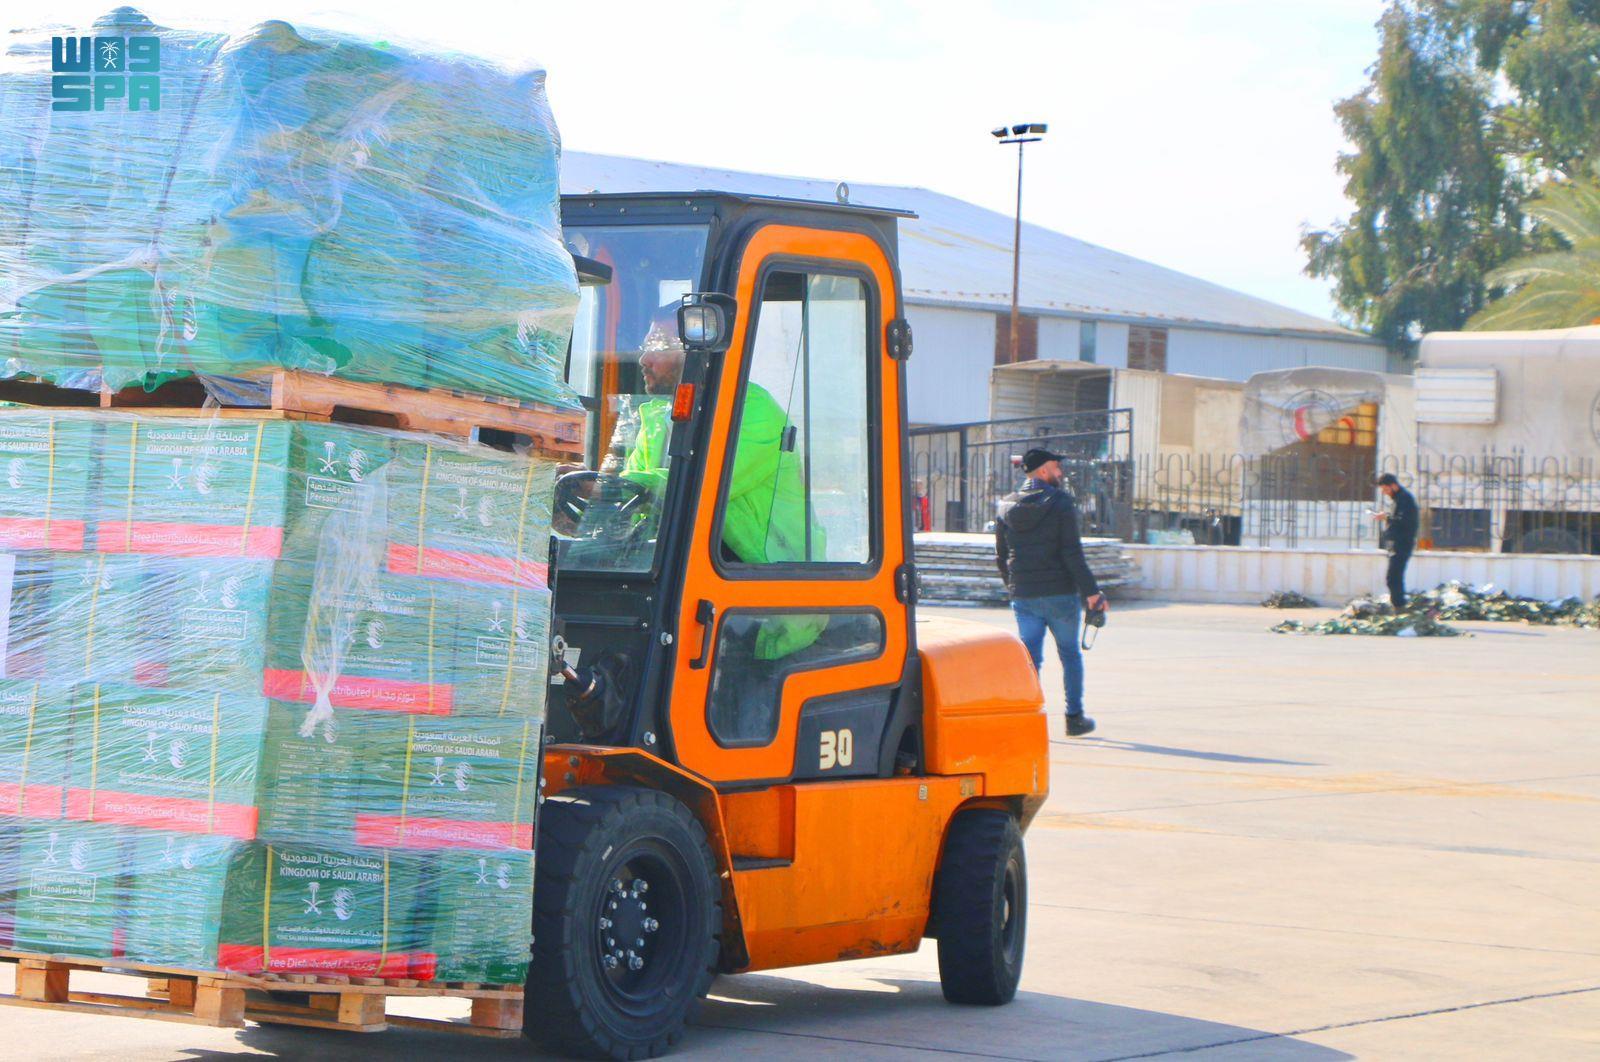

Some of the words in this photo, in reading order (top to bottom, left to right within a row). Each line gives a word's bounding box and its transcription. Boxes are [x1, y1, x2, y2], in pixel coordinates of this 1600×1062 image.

[146, 445, 182, 454] KINGDOM
[183, 446, 193, 454] OF
[219, 447, 248, 456] ARABIA
[332, 685, 371, 698] stributed
[412, 744, 444, 753] KINGDOM
[455, 746, 474, 755] SAUDI
[476, 749, 500, 758] ARABIA
[819, 728, 853, 770] 30
[280, 852, 322, 864] السعودية
[280, 867, 319, 878] KINGDOM
[320, 870, 330, 878] OF
[332, 870, 356, 880] SAUDI
